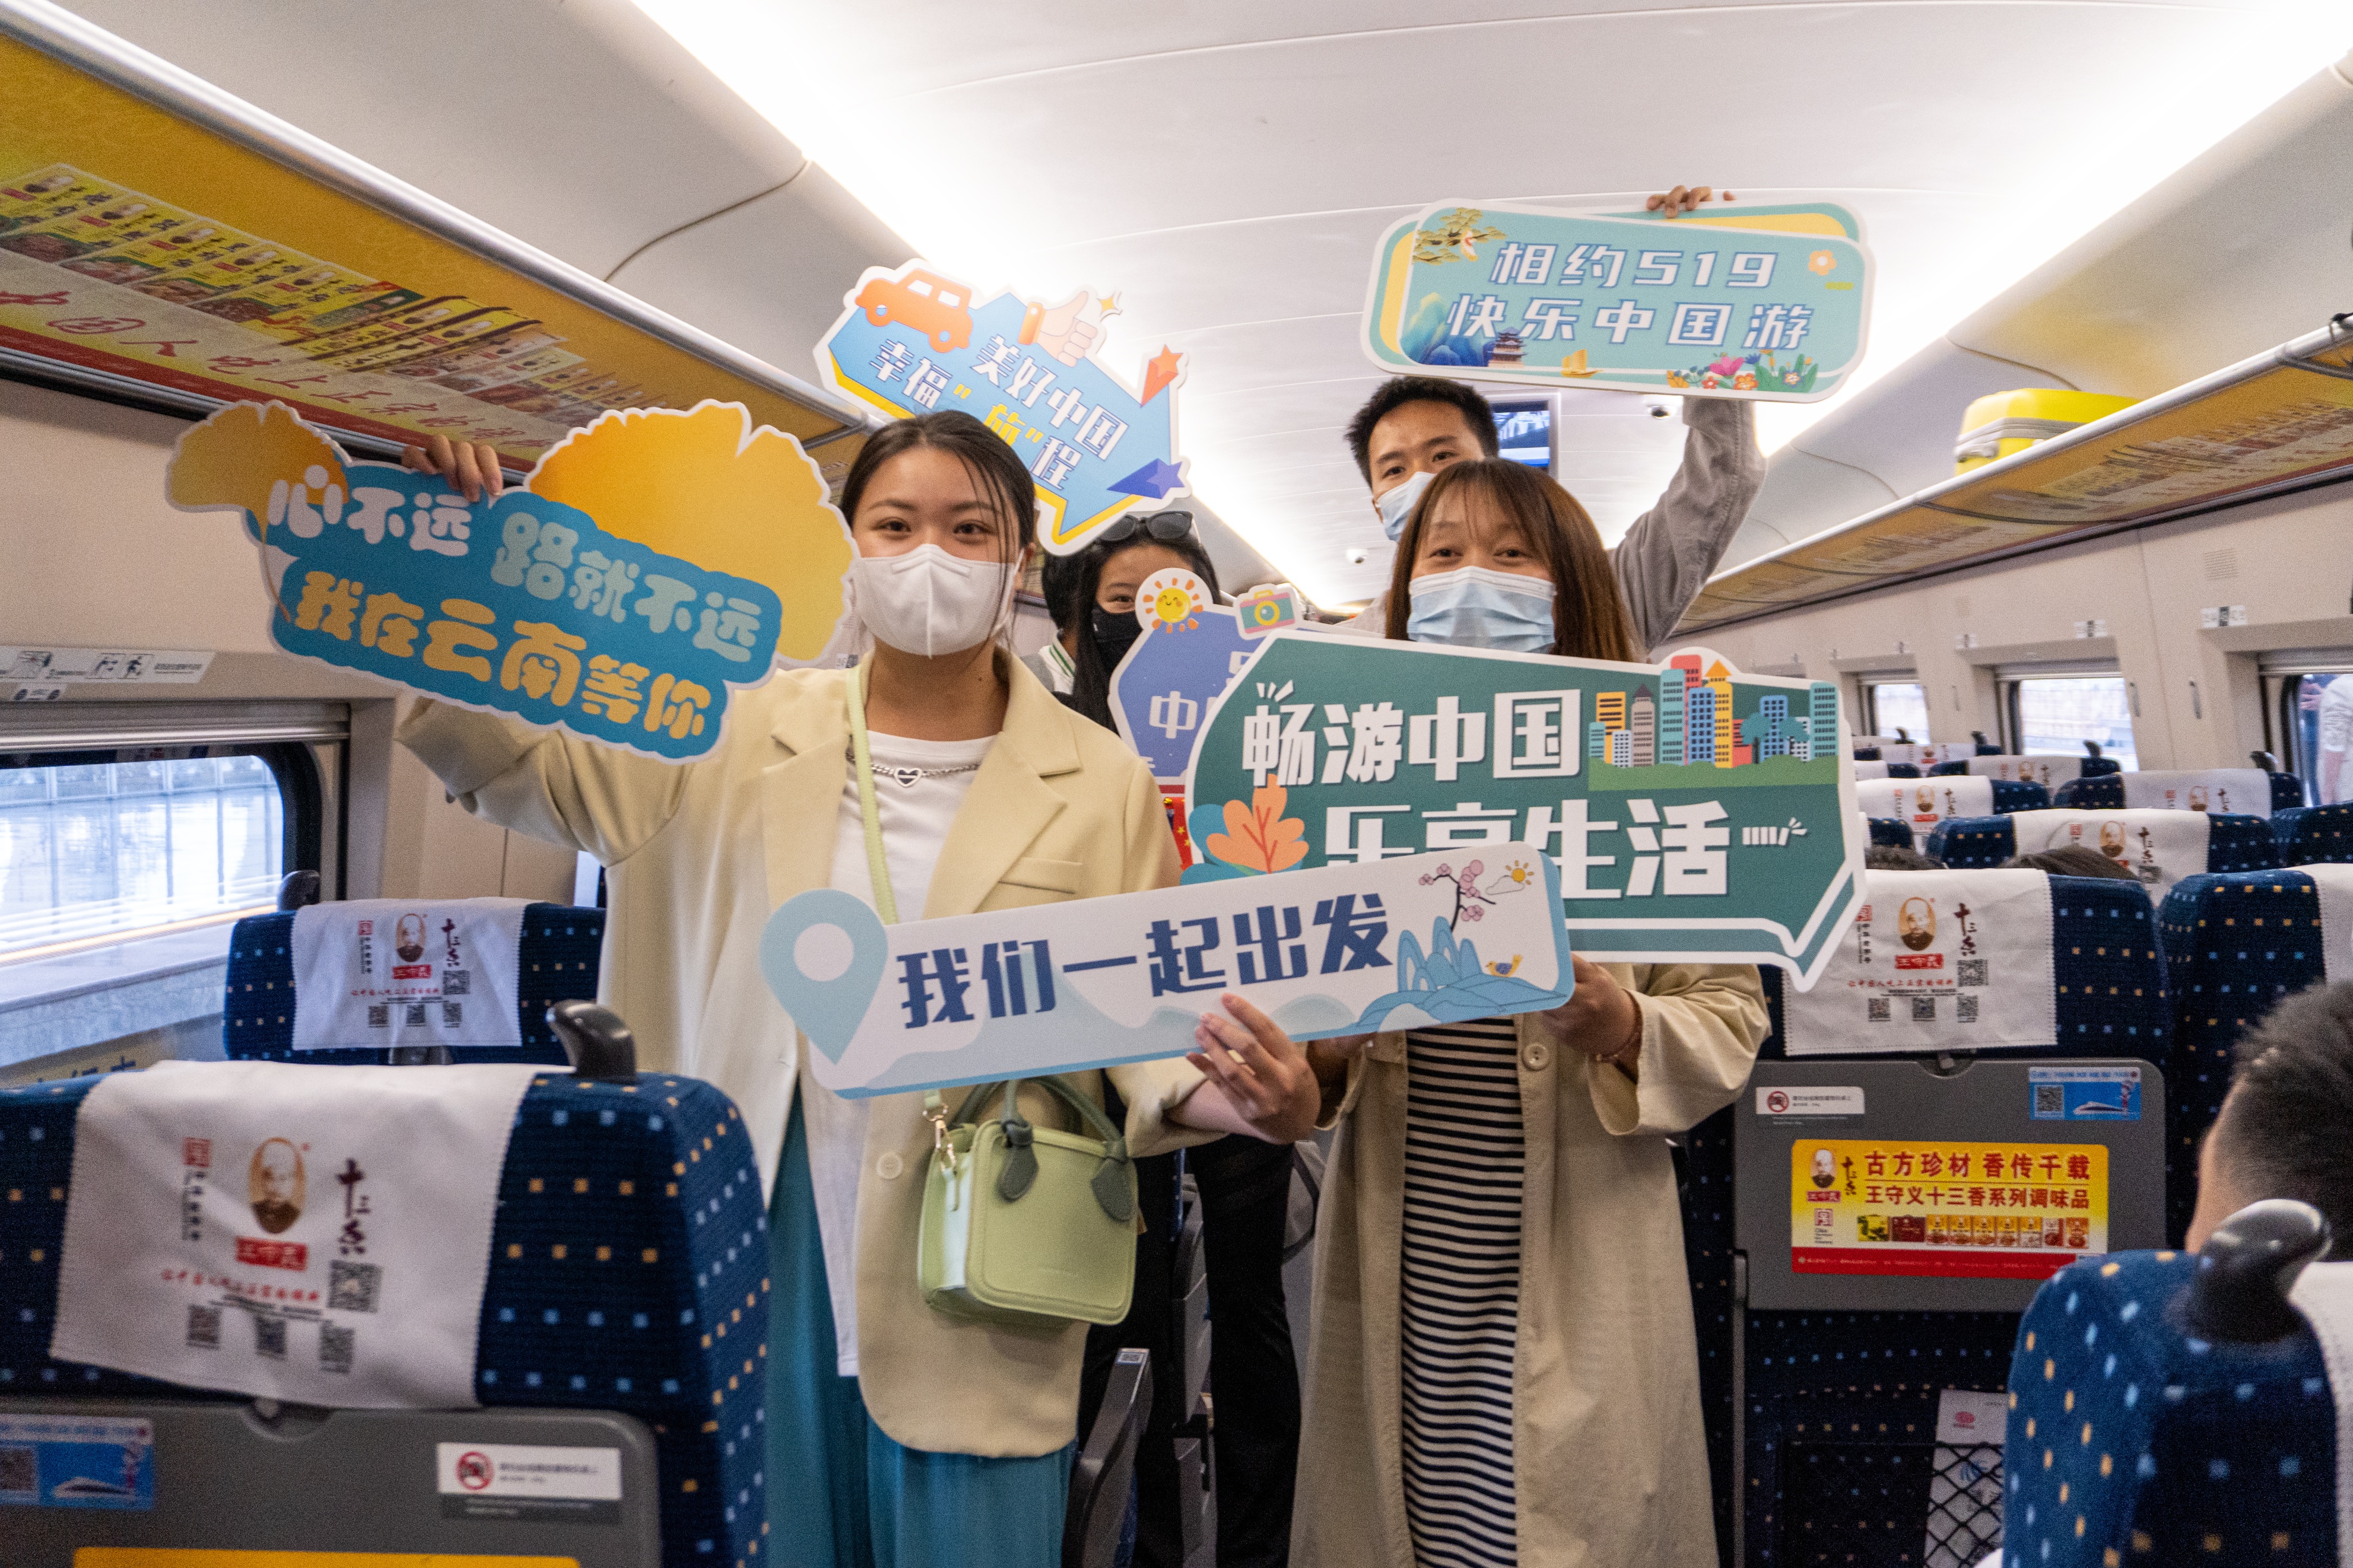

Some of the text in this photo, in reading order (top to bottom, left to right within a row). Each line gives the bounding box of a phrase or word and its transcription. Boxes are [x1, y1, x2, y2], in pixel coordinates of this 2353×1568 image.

[1490, 241, 1779, 289] 相约519
[1447, 293, 1815, 350] 快乐中国游
[971, 334, 1129, 462] 美好中国
[267, 464, 762, 663] 心不远 路就不远
[294, 571, 712, 740] 我在云南等你
[1240, 688, 1582, 788] 畅游中国
[896, 891, 1393, 1030] 我们一起出发
[1864, 1150, 2090, 1180] 古方珍材 香传千载
[1865, 1185, 2090, 1210] 王守义十三香系列调味品
